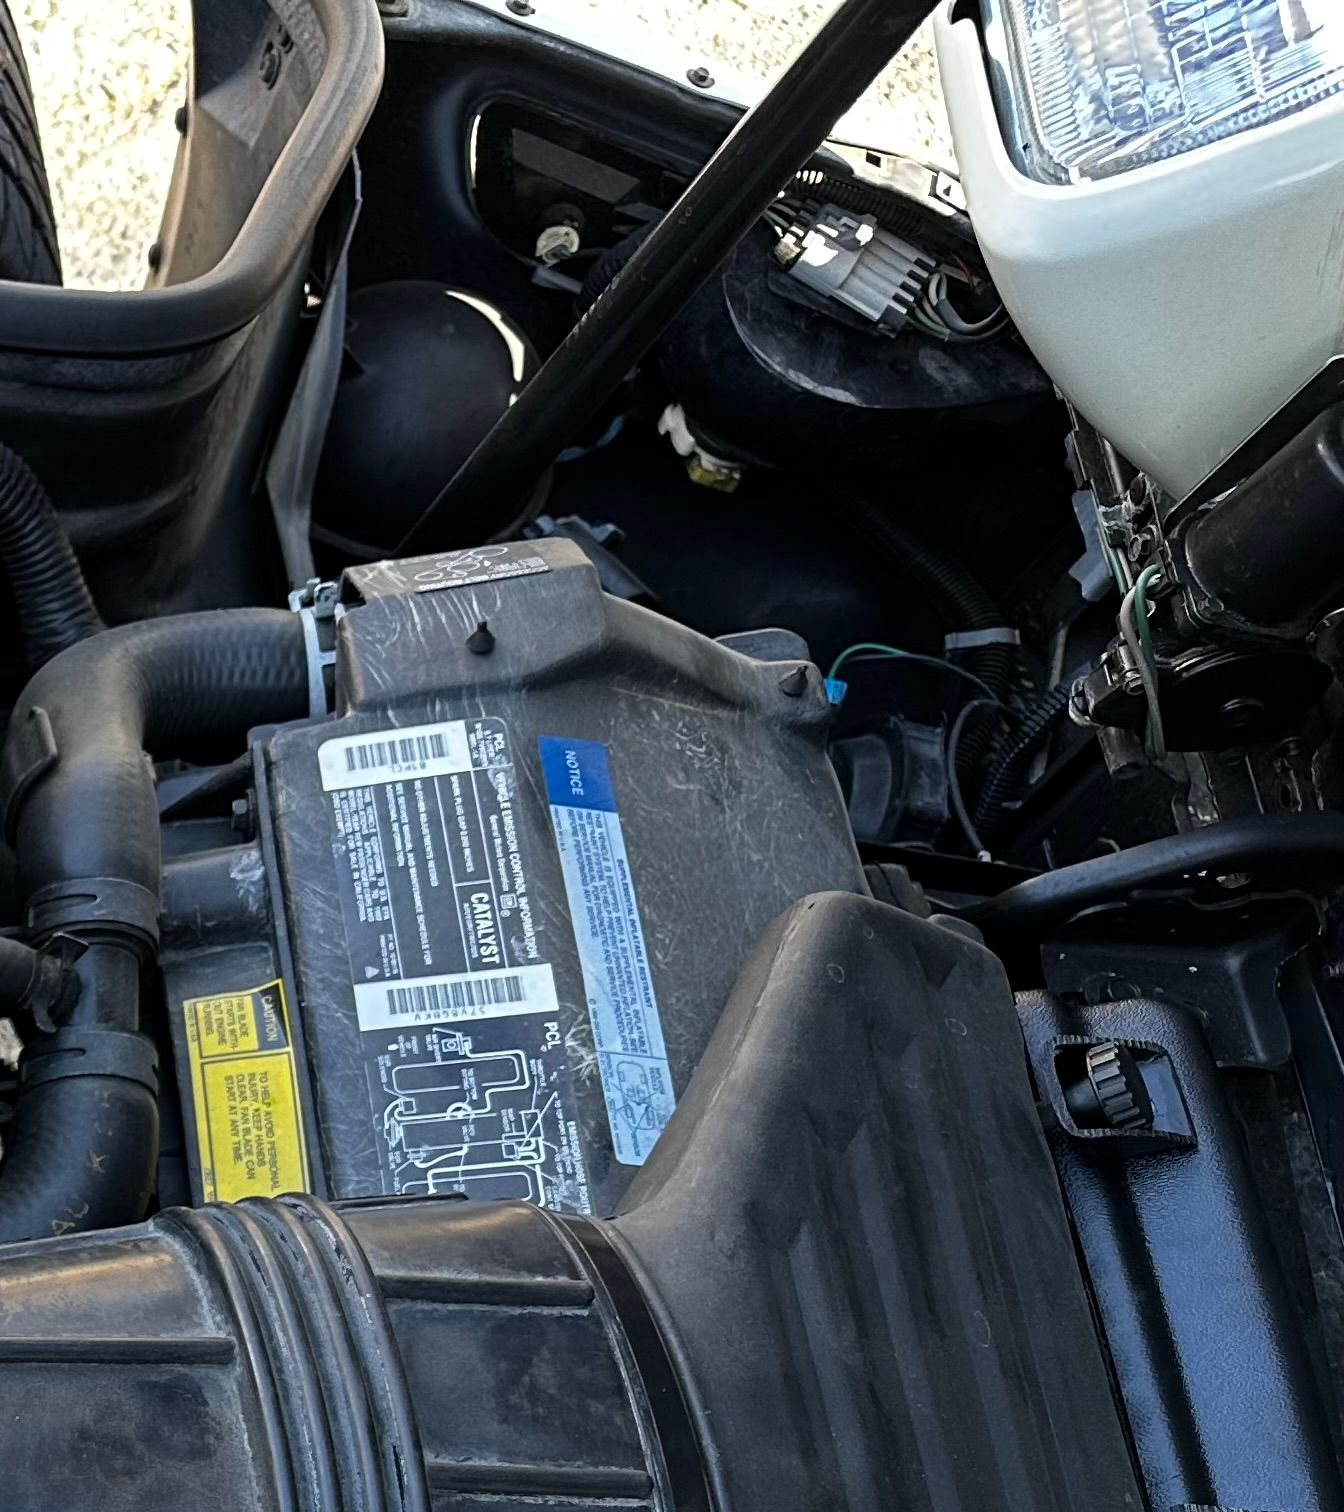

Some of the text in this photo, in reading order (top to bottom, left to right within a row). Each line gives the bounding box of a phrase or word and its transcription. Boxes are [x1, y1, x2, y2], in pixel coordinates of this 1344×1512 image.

[492, 732, 504, 751] PCL
[563, 750, 584, 796] NOTICE
[500, 809, 518, 852] EMISSION
[593, 813, 602, 828] THIS
[567, 808, 588, 886] BEFORE PERFORMING
[597, 832, 609, 862] VEHICLE
[508, 852, 526, 894] CONTROL
[605, 875, 619, 914] EQUIPPED
[469, 891, 500, 965] CATALYST
[516, 896, 537, 959] INFORMATION
[613, 915, 623, 935] WITH
[616, 858, 653, 1009] SUPPLEMENTAL INFLATABLE RESTRAINT
[619, 945, 637, 1006] SUPPLEMENTAL
[215, 1018, 225, 1046] ENGINE
[238, 1014, 248, 1038] BLADE
[261, 994, 277, 1042] CAUTION
[631, 1007, 646, 1055] INFLATABLE
[542, 1021, 562, 1048] PCL
[224, 1075, 236, 1104] START
[227, 1105, 237, 1116] AT
[239, 1107, 249, 1125] FAN
[229, 1119, 239, 1138] ANY
[241, 1127, 253, 1158] BLADE
[258, 1071, 281, 1192] TO HELP AVOID PERSONAL
[254, 1133, 266, 1167] HANDS
[245, 1159, 255, 1179] CAN
